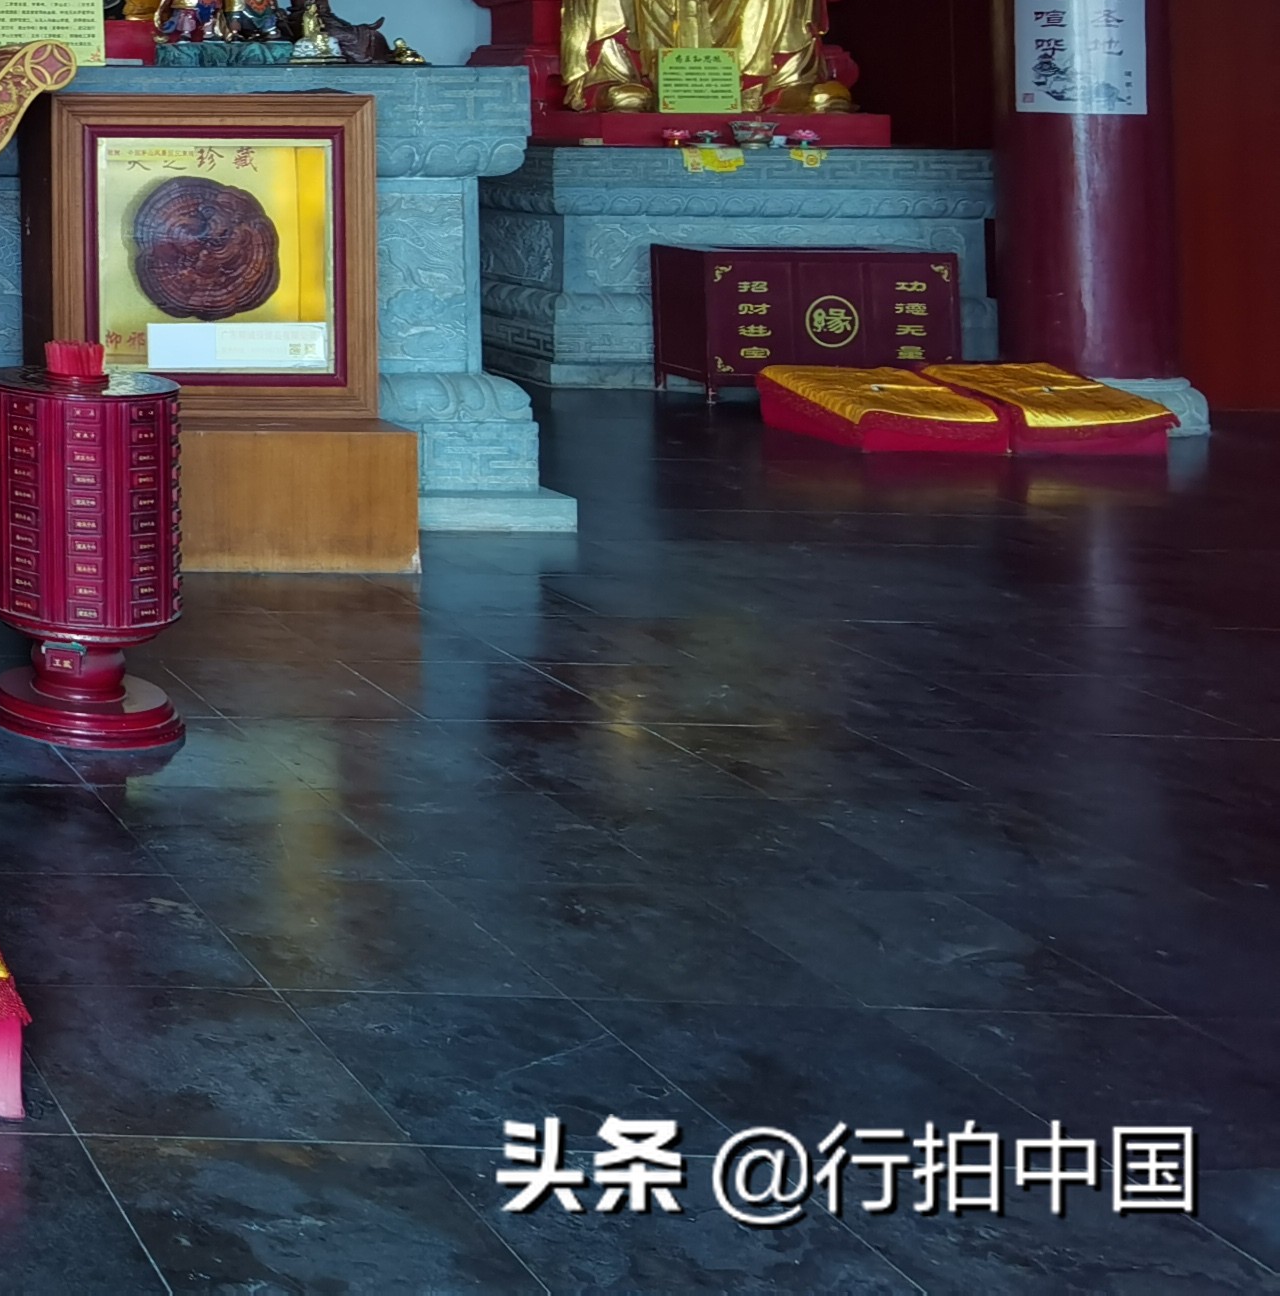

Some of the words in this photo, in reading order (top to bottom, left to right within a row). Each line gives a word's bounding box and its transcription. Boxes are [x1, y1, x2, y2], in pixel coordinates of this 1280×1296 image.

[737, 281, 772, 359] 招财进宝
[895, 280, 928, 360] 功德无量
